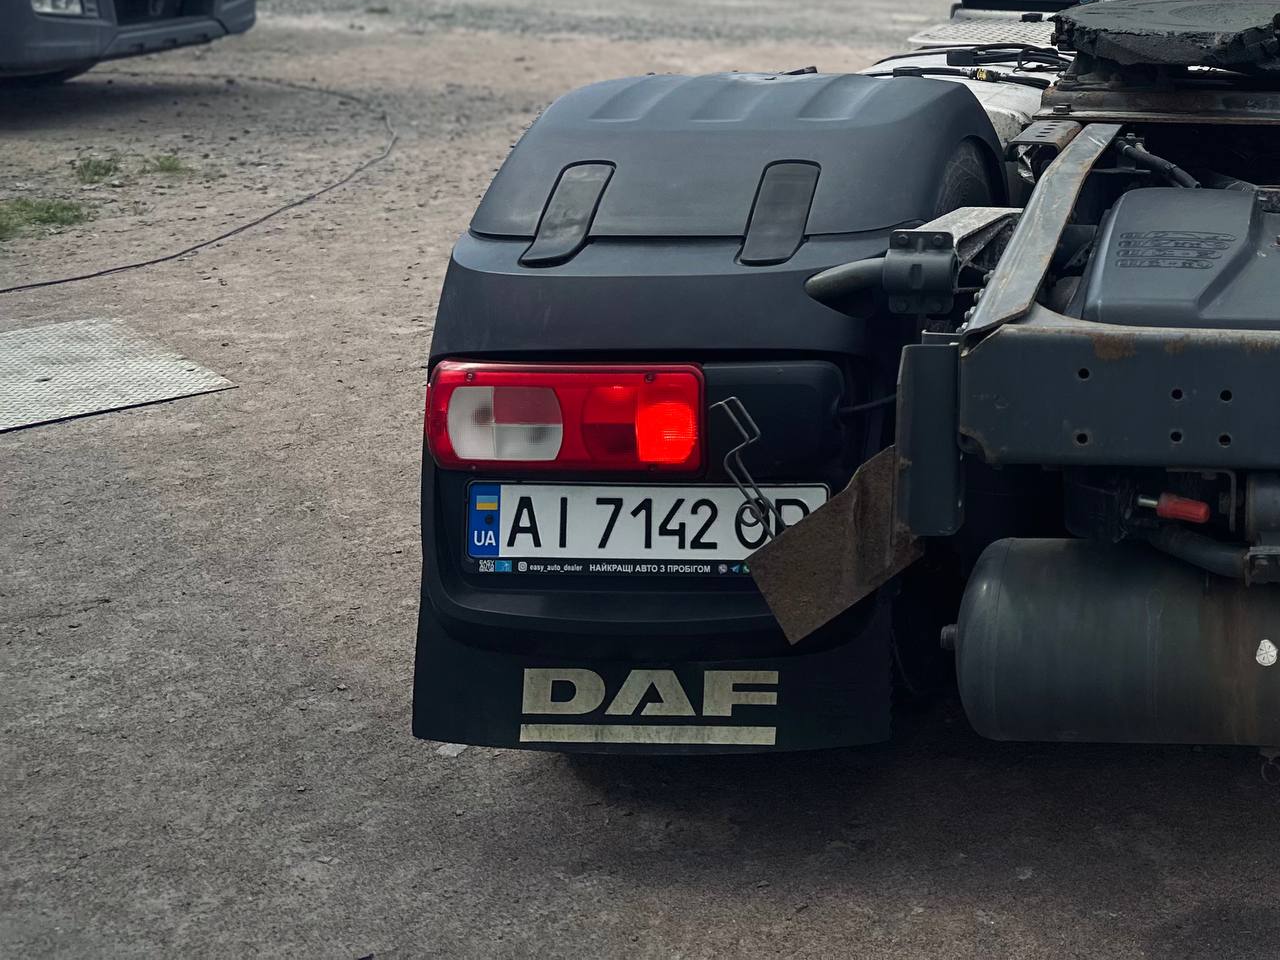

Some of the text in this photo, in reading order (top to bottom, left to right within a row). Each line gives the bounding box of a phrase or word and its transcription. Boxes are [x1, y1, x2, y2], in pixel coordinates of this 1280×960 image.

[507, 496, 568, 548] AI
[595, 497, 718, 550] 7142
[474, 530, 496, 546] UA
[529, 564, 583, 573] easy_auto_dealer
[589, 562, 634, 573] НАЙКРАЩІ
[635, 564, 658, 573] АВТО
[667, 565, 711, 573] ПРОБІГОМ
[521, 668, 779, 717] DAF
